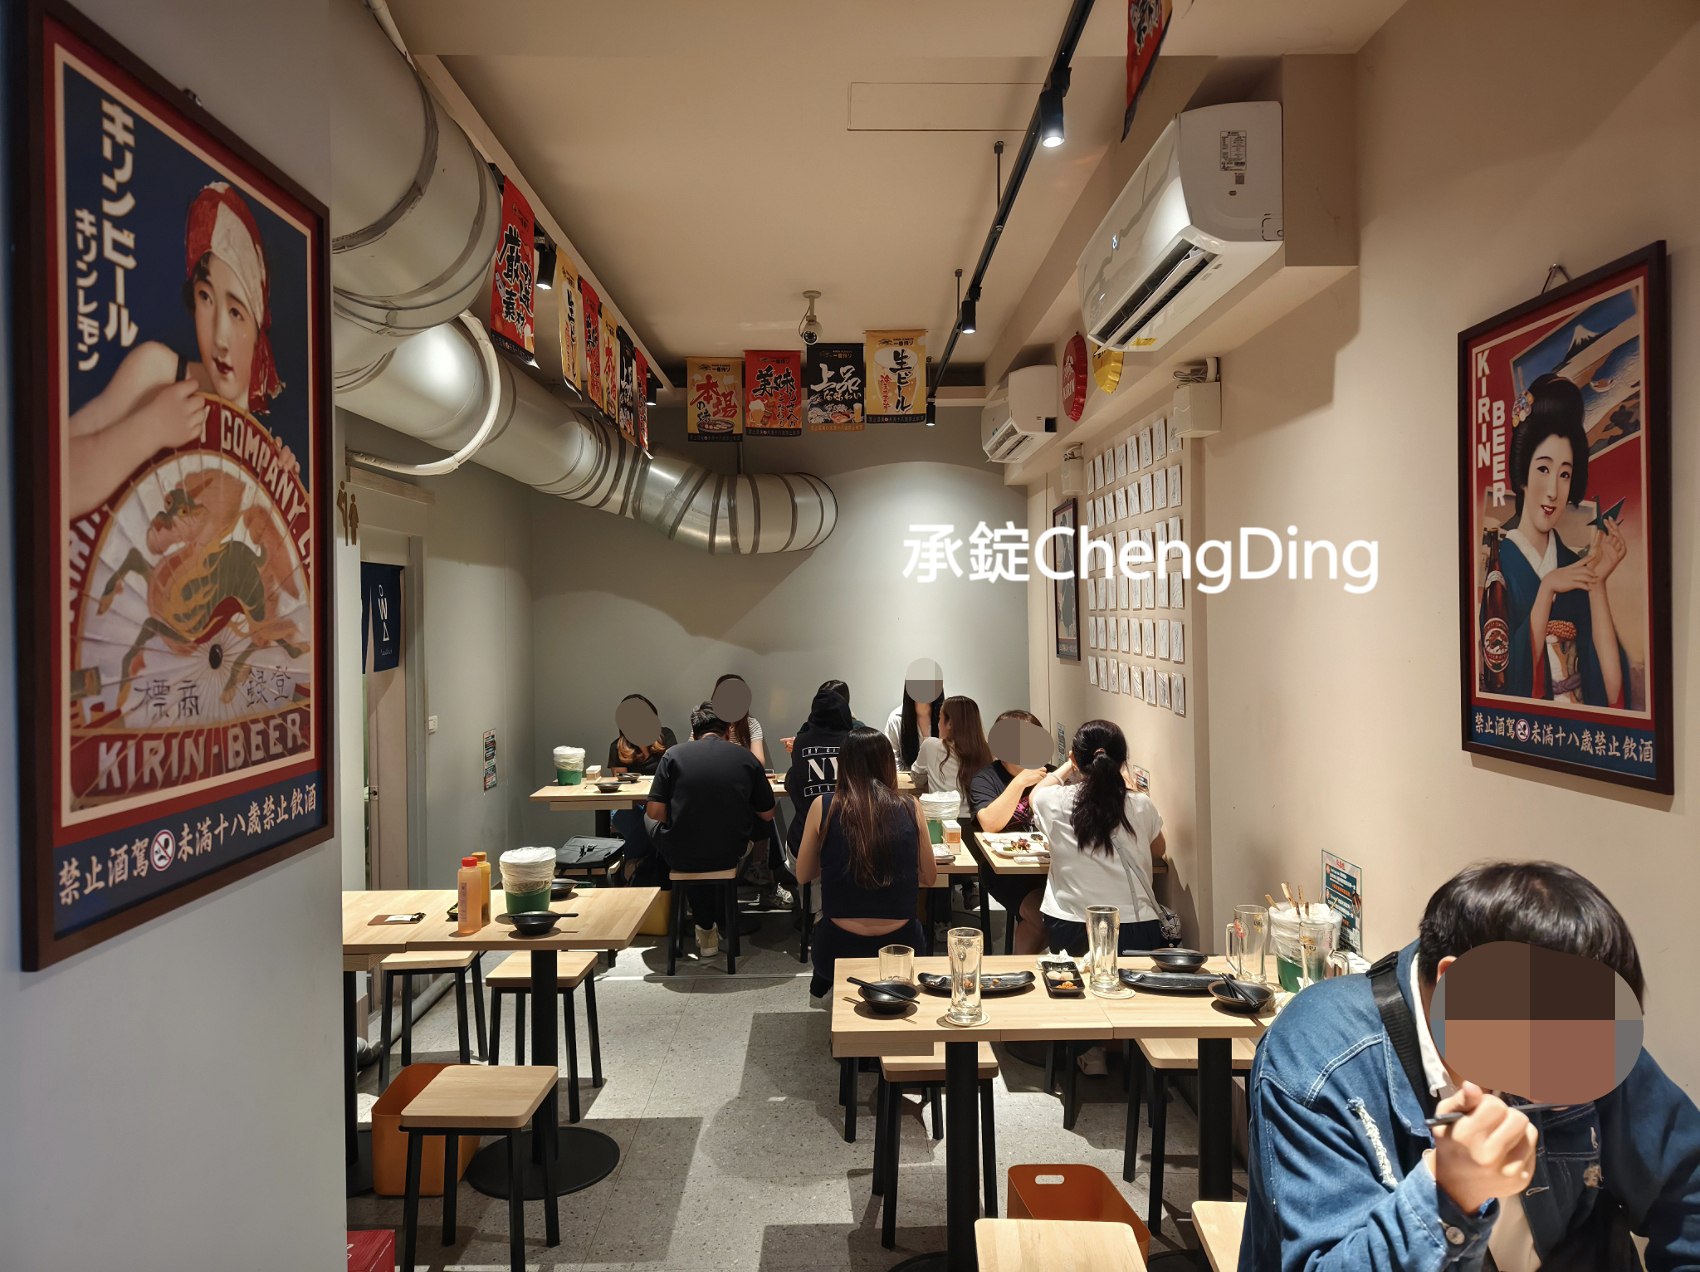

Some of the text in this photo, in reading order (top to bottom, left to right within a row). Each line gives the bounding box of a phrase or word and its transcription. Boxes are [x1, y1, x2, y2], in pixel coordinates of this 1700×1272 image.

[101, 98, 139, 347] キリンビール
[888, 349, 912, 413] 生ビール
[1477, 350, 1490, 468] KIRIN
[221, 409, 307, 523] COMPANY
[1492, 399, 1506, 508] BEER
[1475, 712, 1654, 764] 禁止酒駕 未滿十八歲禁止飲酒
[58, 783, 317, 906] 禁止酒駕 未滿十八歲禁止飲酒
